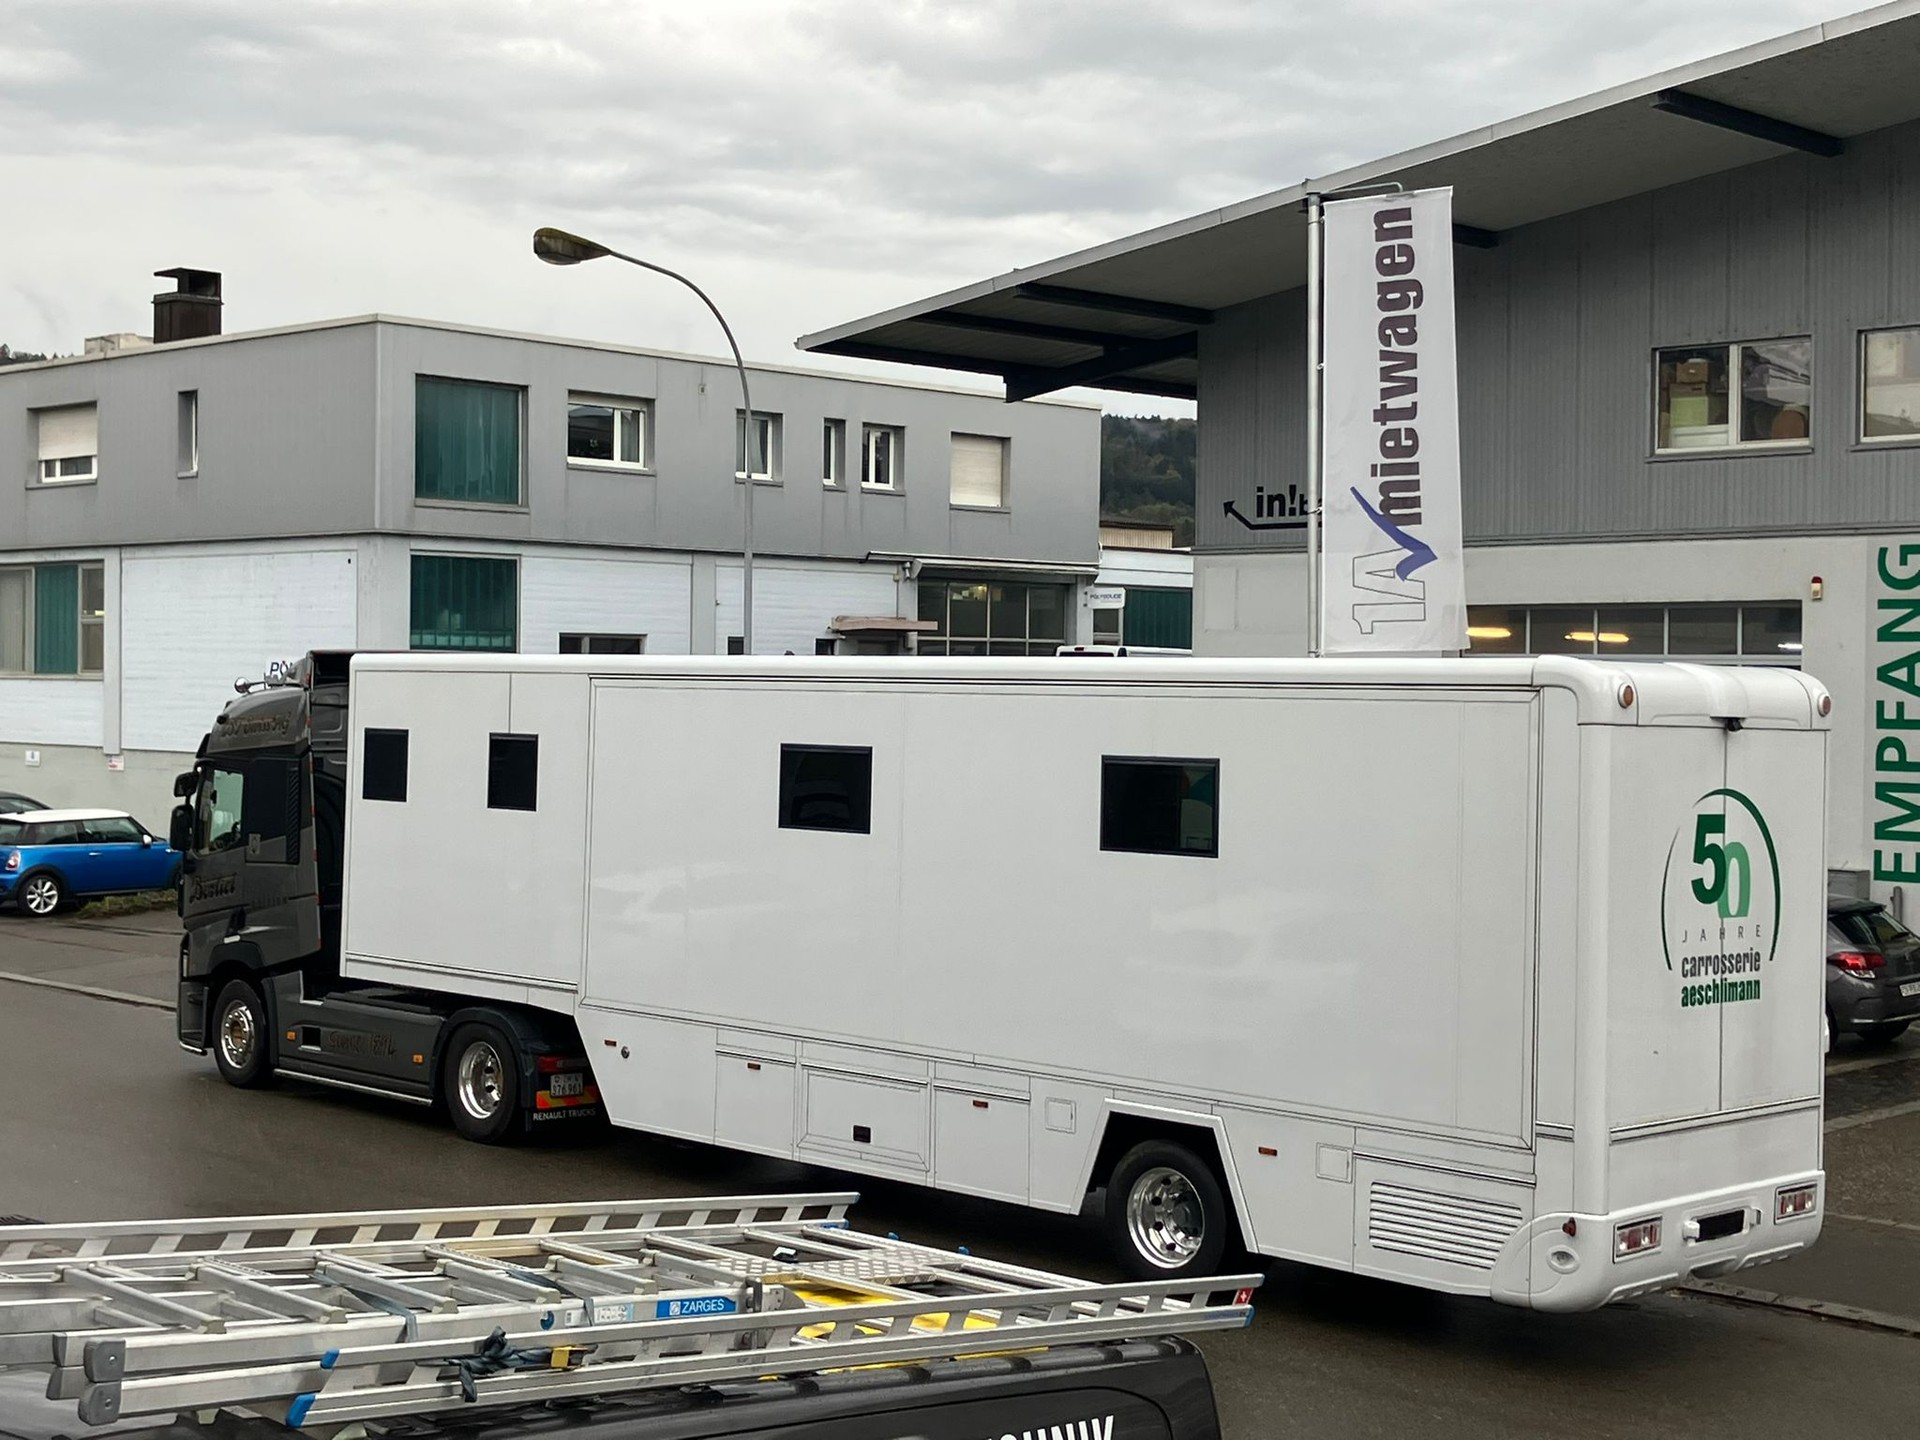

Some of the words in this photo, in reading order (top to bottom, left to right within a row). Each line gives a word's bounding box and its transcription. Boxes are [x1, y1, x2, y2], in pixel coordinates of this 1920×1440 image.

[1371, 207, 1424, 526] mietwagen
[1353, 547, 1426, 634] 1A
[1874, 544, 1920, 884] EMPFANG
[1682, 925, 1761, 943] JAHRE
[1681, 947, 1761, 978] carrosserie
[1681, 978, 1761, 1008] aeschlimann
[533, 1110, 566, 1121] RENAULT
[568, 1108, 596, 1118] TRUCKS
[681, 1298, 725, 1314] ZARGES
